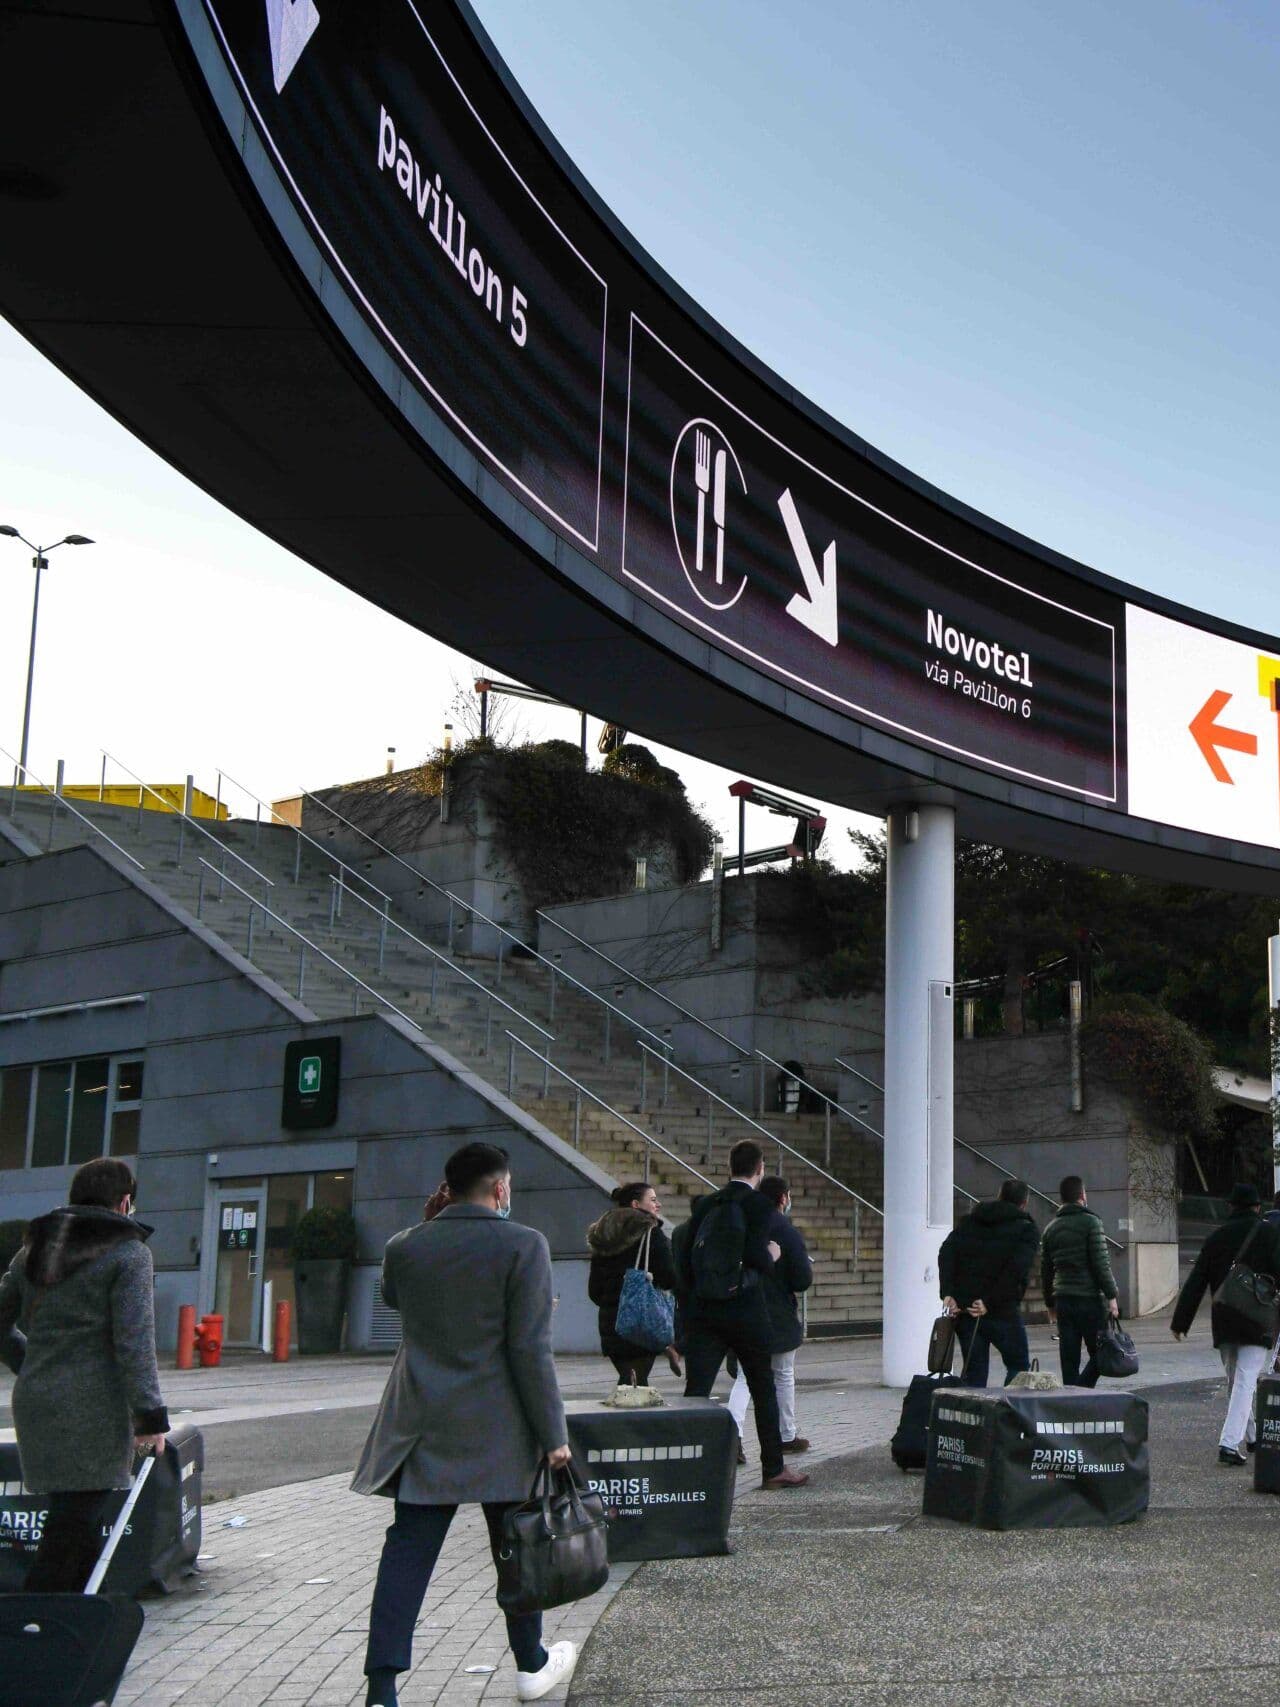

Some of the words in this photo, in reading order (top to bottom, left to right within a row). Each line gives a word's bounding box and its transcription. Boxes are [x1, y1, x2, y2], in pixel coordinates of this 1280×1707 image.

[378, 104, 502, 323] pavillon
[511, 286, 528, 347] 5
[926, 608, 1033, 688] Novotel
[925, 660, 949, 686] via
[953, 670, 1017, 714] Pavillon
[1021, 699, 1032, 719] 6
[938, 1435, 961, 1452] PARIS
[1032, 1449, 1078, 1464] PARIS
[1031, 1462, 1061, 1471] PORTE
[1063, 1463, 1076, 1472] DE
[1077, 1462, 1125, 1473] VERSAILLES
[587, 1478, 641, 1495] PARIS
[602, 1495, 623, 1506] RTE
[625, 1496, 640, 1505] DE
[642, 1492, 707, 1504] VERSAILLES
[0, 1510, 49, 1529] ARIS
[32, 1529, 44, 1540] D
